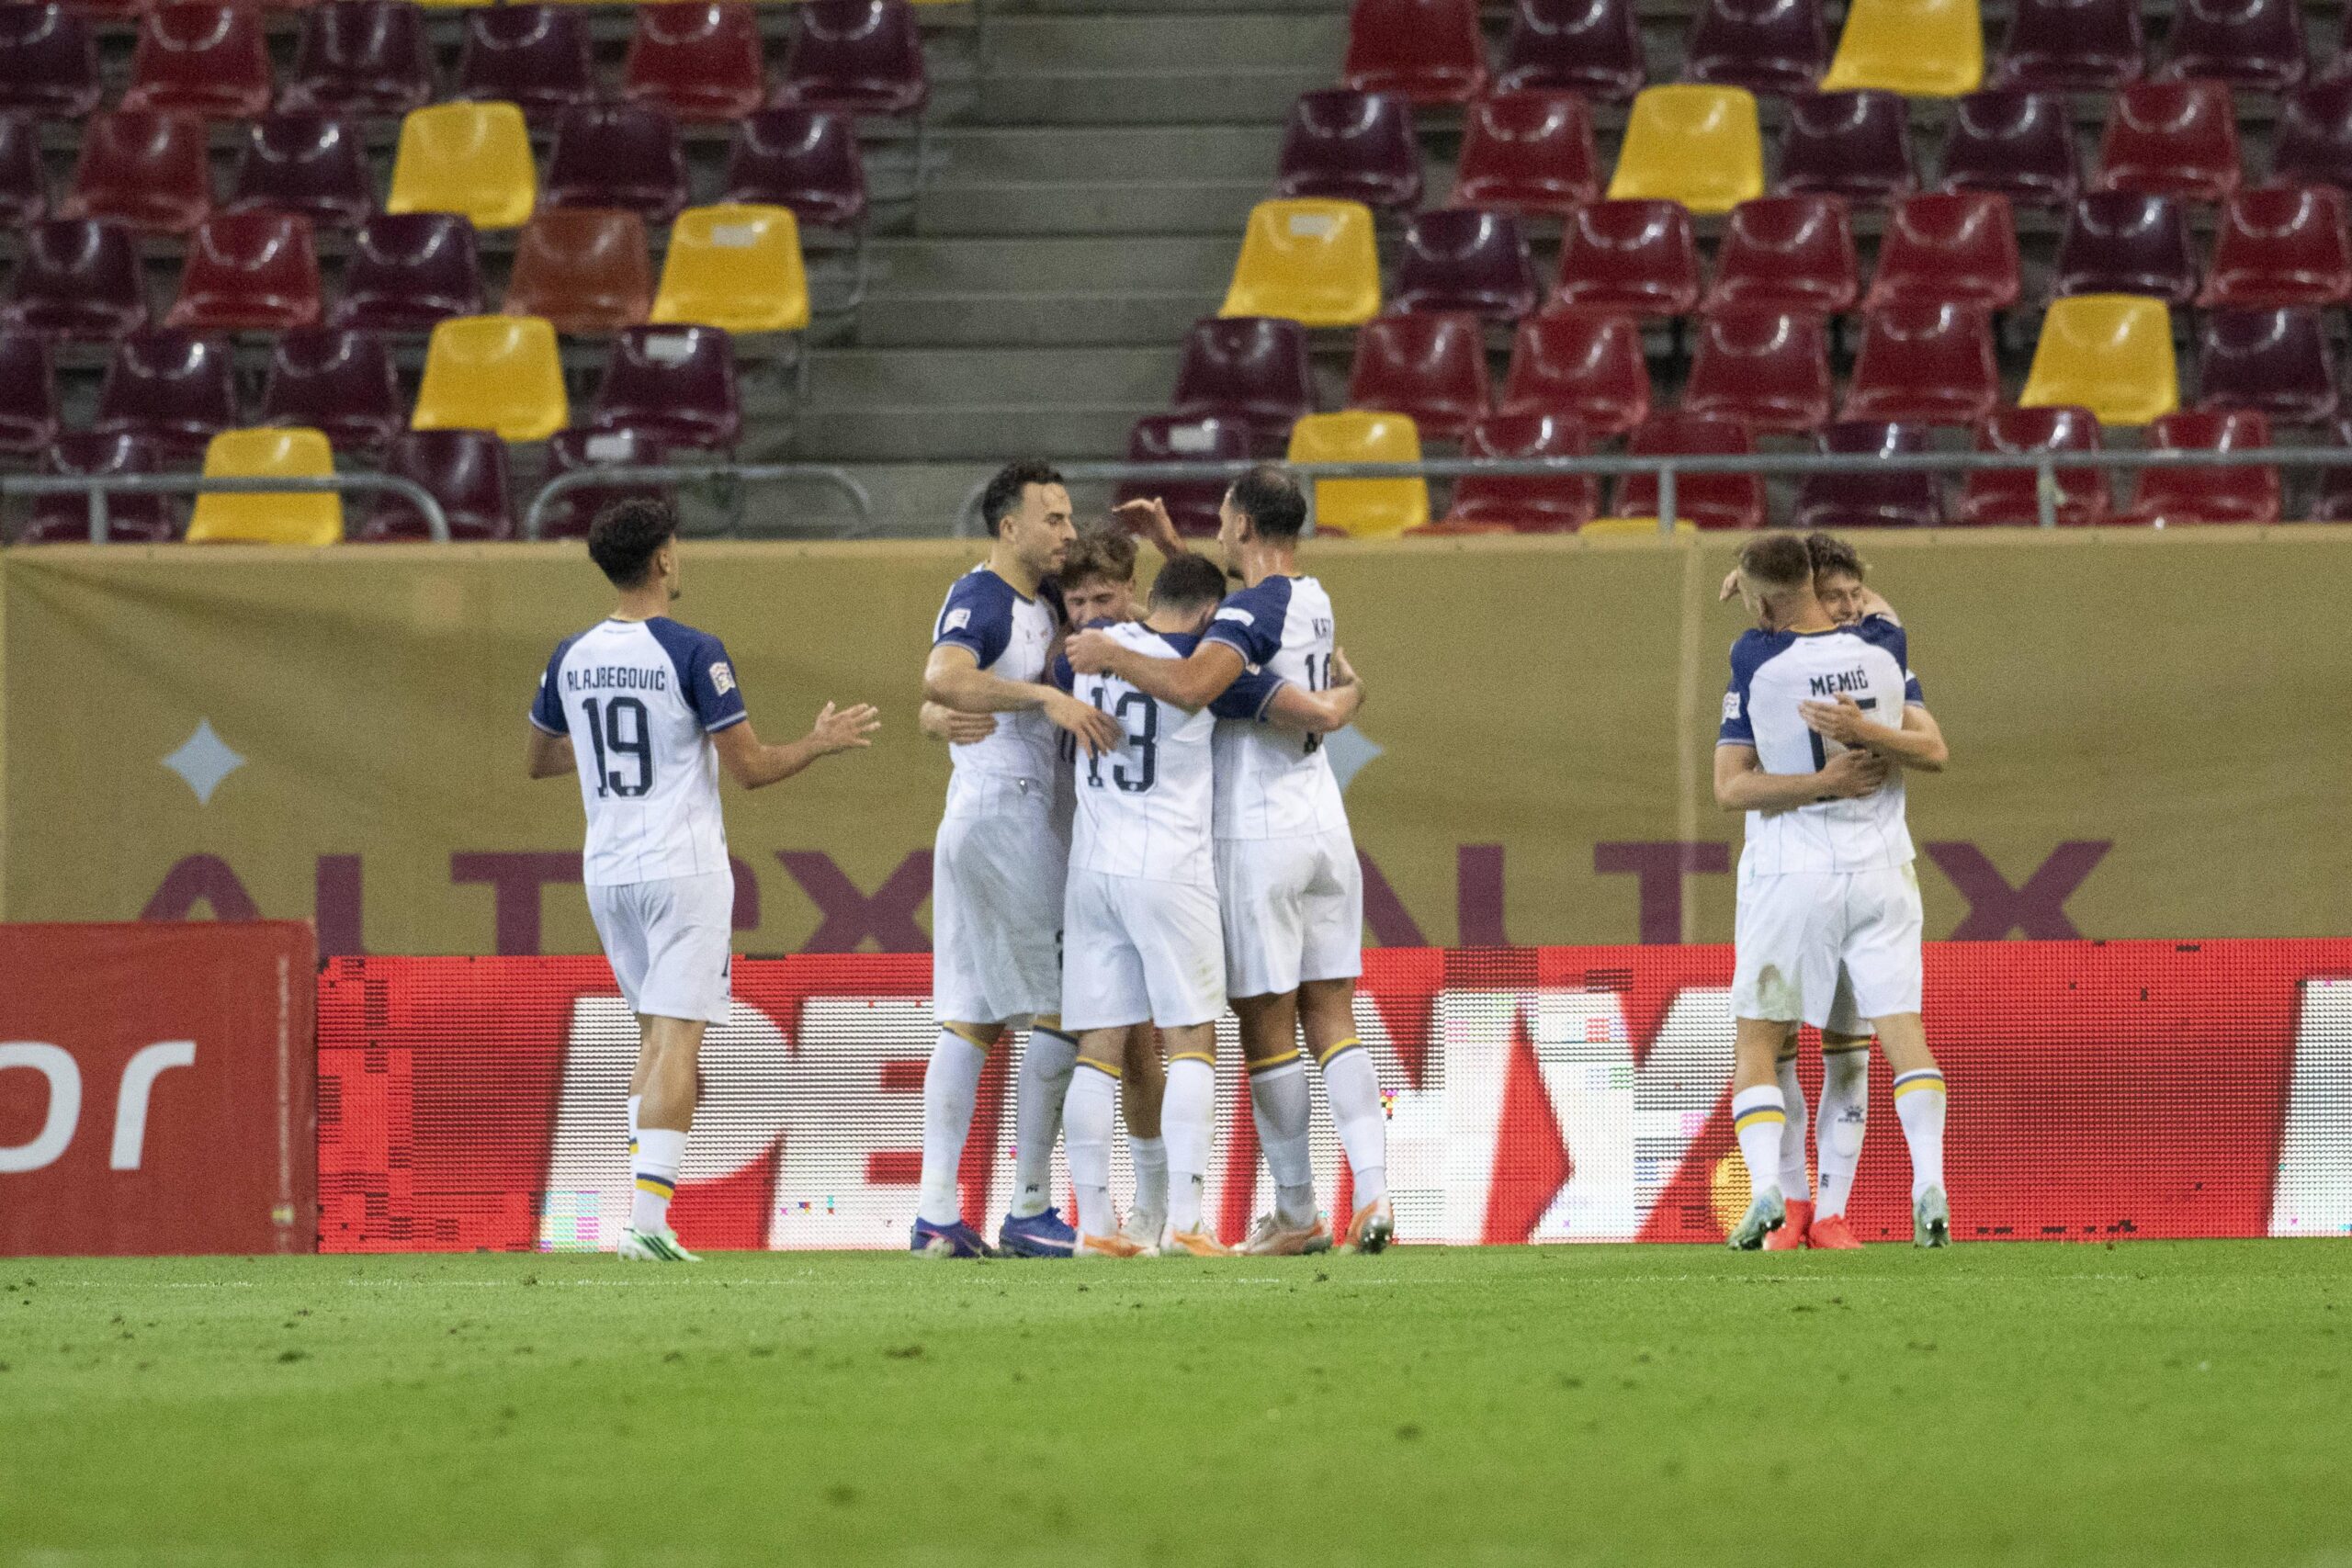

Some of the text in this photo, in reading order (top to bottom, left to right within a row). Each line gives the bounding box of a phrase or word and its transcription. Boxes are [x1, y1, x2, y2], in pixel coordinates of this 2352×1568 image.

[567, 665, 666, 693] ALAJBEGOVIĆ
[1809, 665, 1869, 696] MEMIĆ
[582, 696, 655, 799] 19
[1088, 687, 1159, 793] 13
